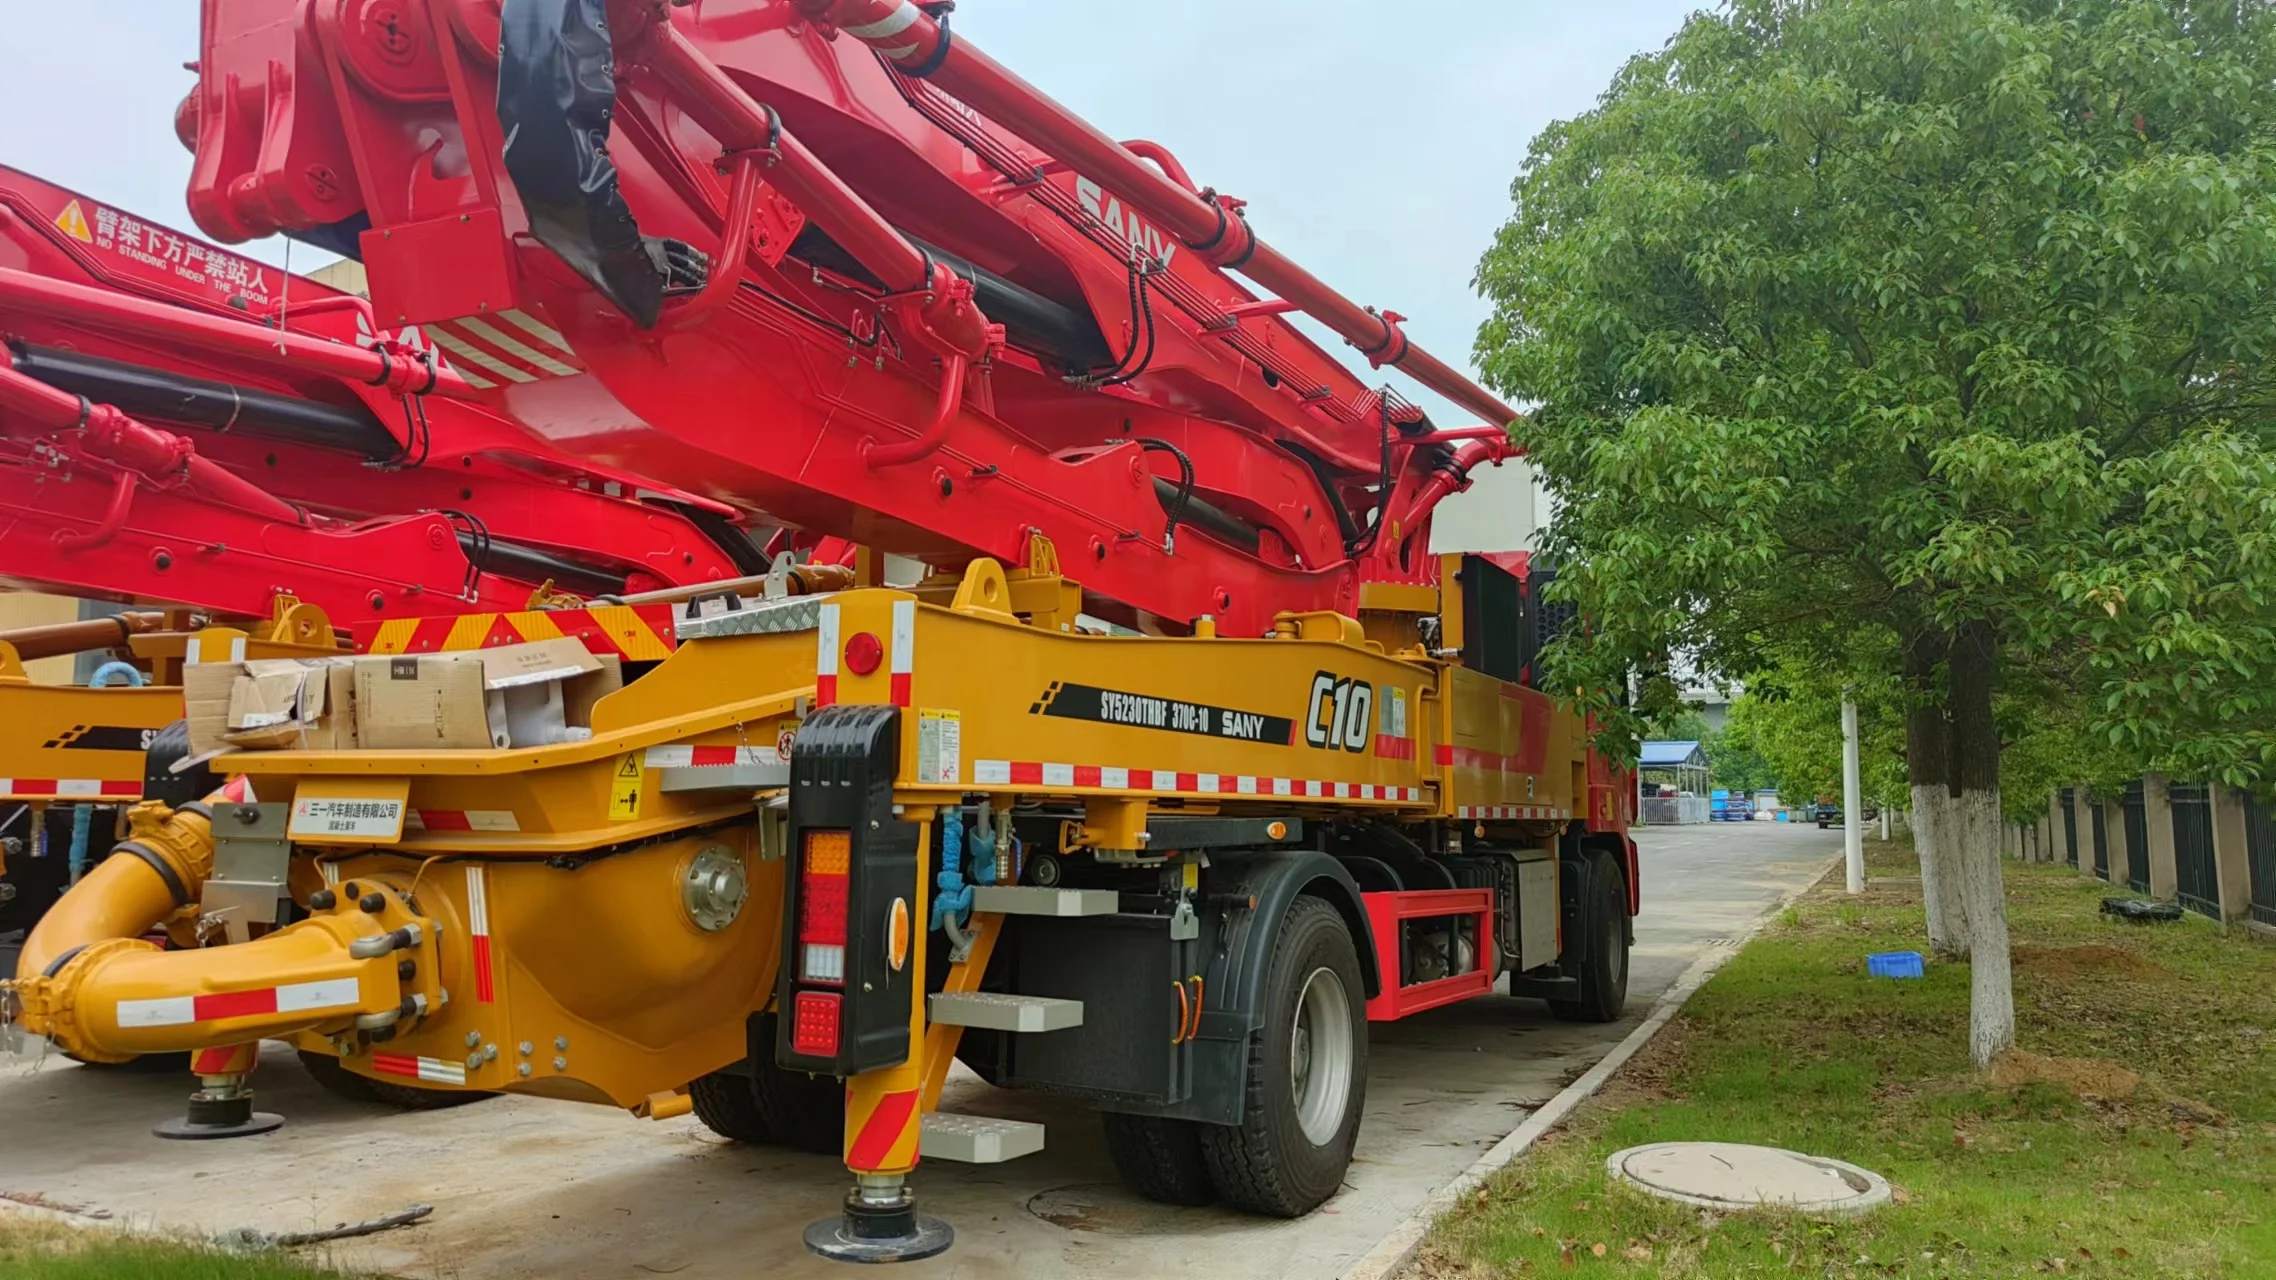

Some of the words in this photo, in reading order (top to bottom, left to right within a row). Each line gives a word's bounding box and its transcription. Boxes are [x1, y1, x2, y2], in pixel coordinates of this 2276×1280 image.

[95, 206, 268, 294] 臂架下方严禁站人
[96, 236, 112, 249] NO
[118, 245, 167, 270] STANDING
[175, 266, 205, 285] UNDER
[215, 279, 231, 293] THE
[240, 287, 268, 305] BOOM
[1100, 691, 1167, 727] SY5230THBF
[1172, 702, 1209, 732] 370C-10
[1222, 711, 1264, 739] SANY
[1306, 669, 1373, 754] C10
[309, 802, 399, 819] 三一汽车制造有限公司
